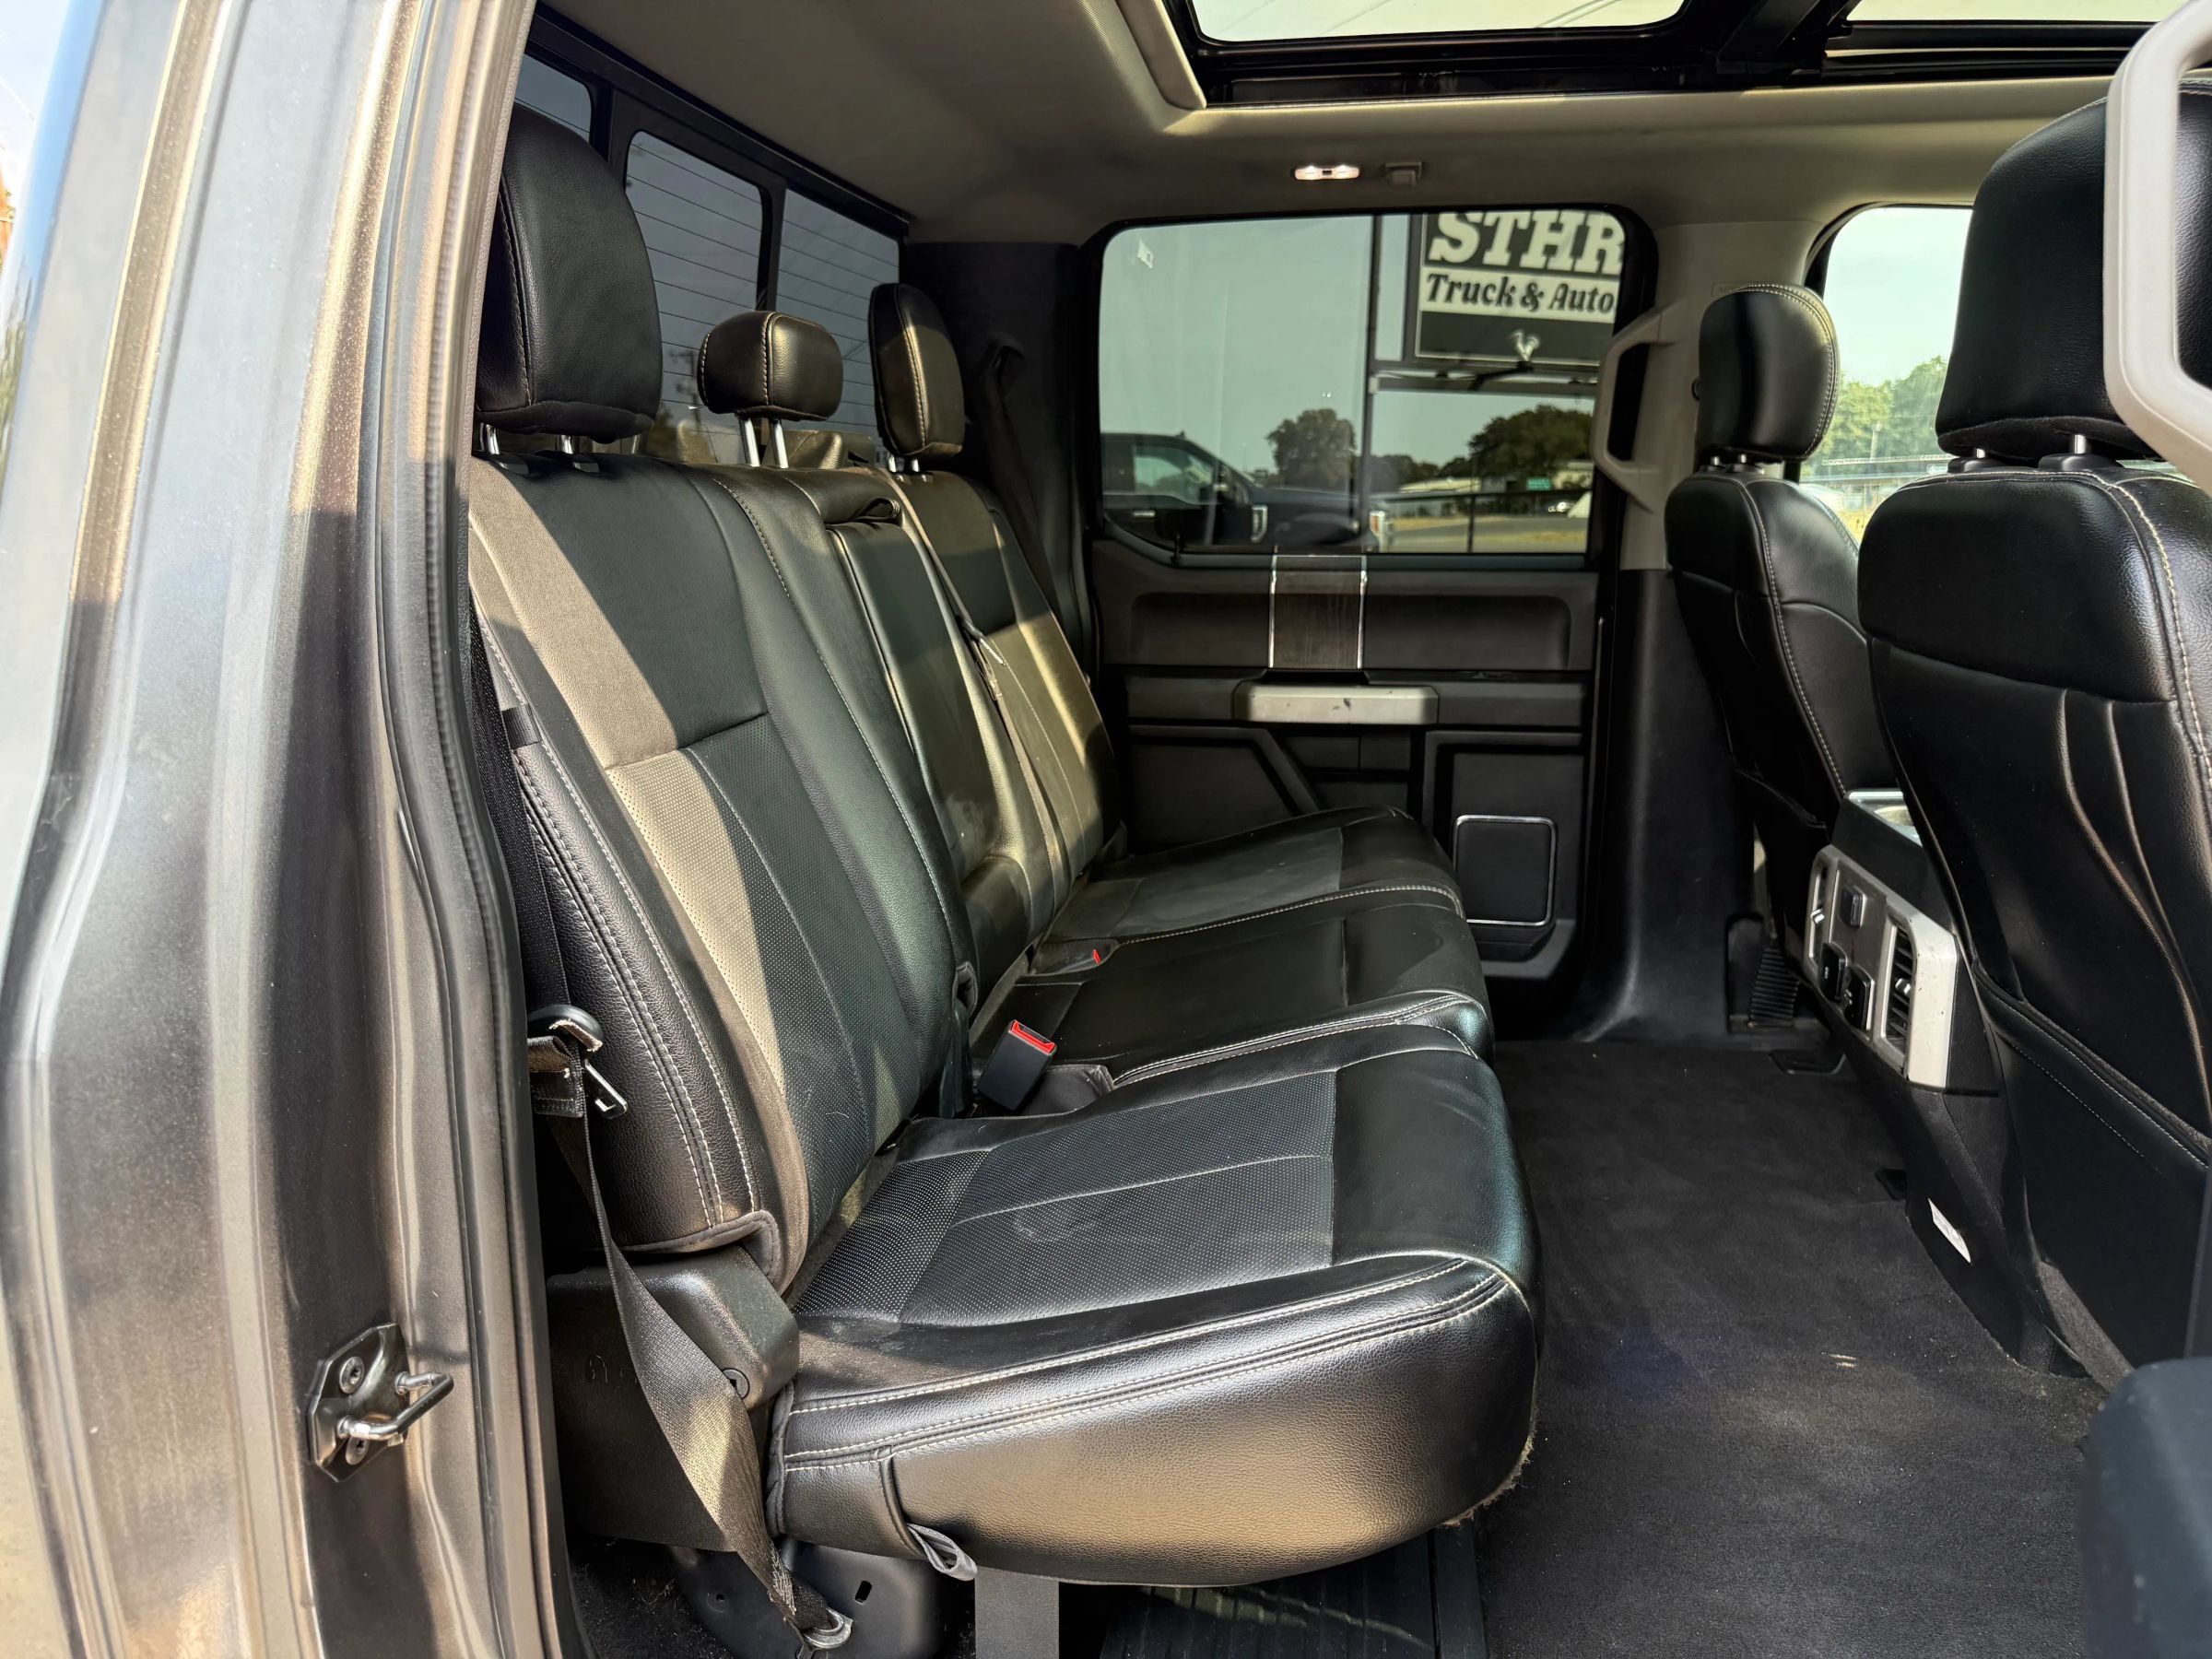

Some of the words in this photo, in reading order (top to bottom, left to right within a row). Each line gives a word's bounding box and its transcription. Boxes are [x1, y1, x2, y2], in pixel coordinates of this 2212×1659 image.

[1427, 273, 1517, 307] Truck
[1521, 282, 1544, 312] &
[1547, 283, 1615, 313] Auto
